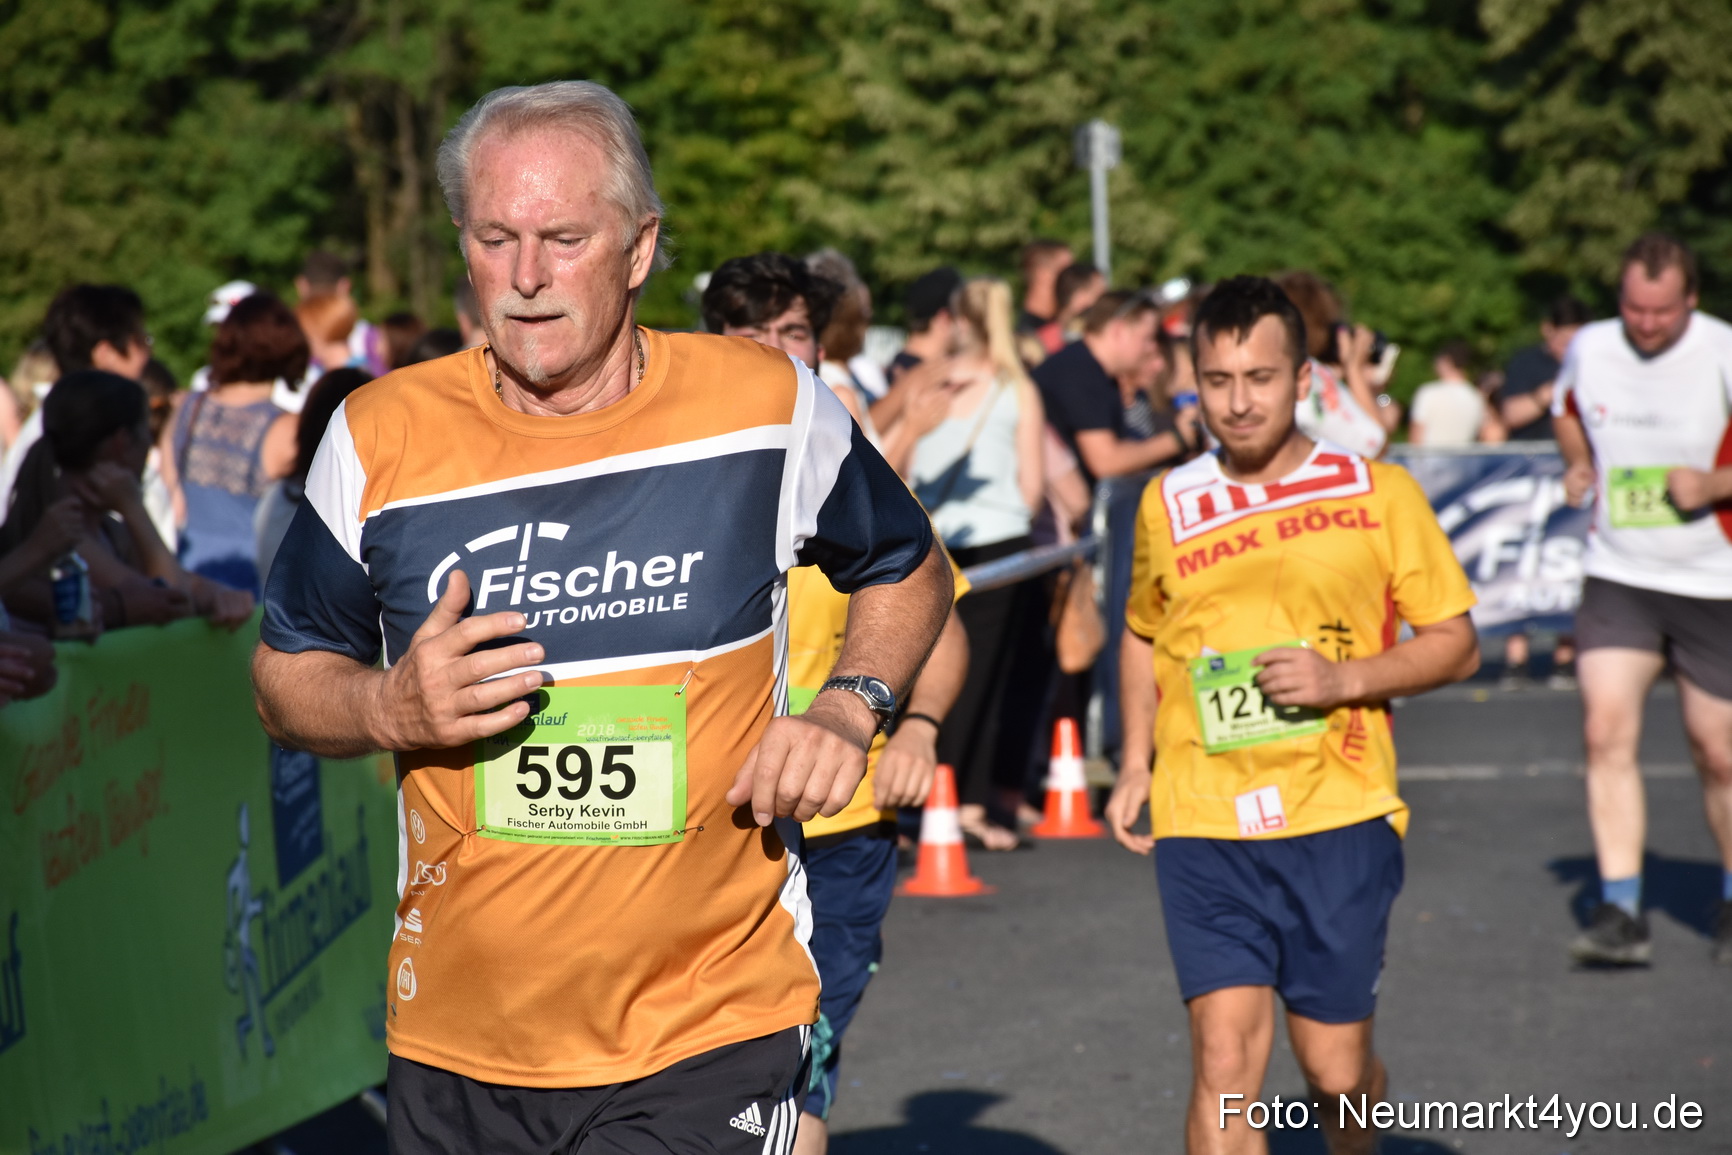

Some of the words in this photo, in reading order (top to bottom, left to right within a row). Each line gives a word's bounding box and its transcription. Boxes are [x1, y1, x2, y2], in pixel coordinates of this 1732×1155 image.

[1175, 527, 1264, 580] MAX
[1275, 506, 1382, 543] BÖGL
[1477, 522, 1586, 582] Fis
[476, 550, 704, 610] Fischer
[522, 592, 689, 629] UTOMOBILE
[523, 712, 568, 726] enlauf
[577, 724, 615, 737] 2018
[516, 745, 637, 800] 595
[528, 803, 574, 818] Serby
[580, 803, 626, 817] Kevin
[507, 817, 545, 830] Fischer
[548, 819, 611, 830] Automobile
[613, 820, 648, 830] GmbH
[399, 967, 411, 992] FIAT
[729, 1116, 766, 1137] adidas
